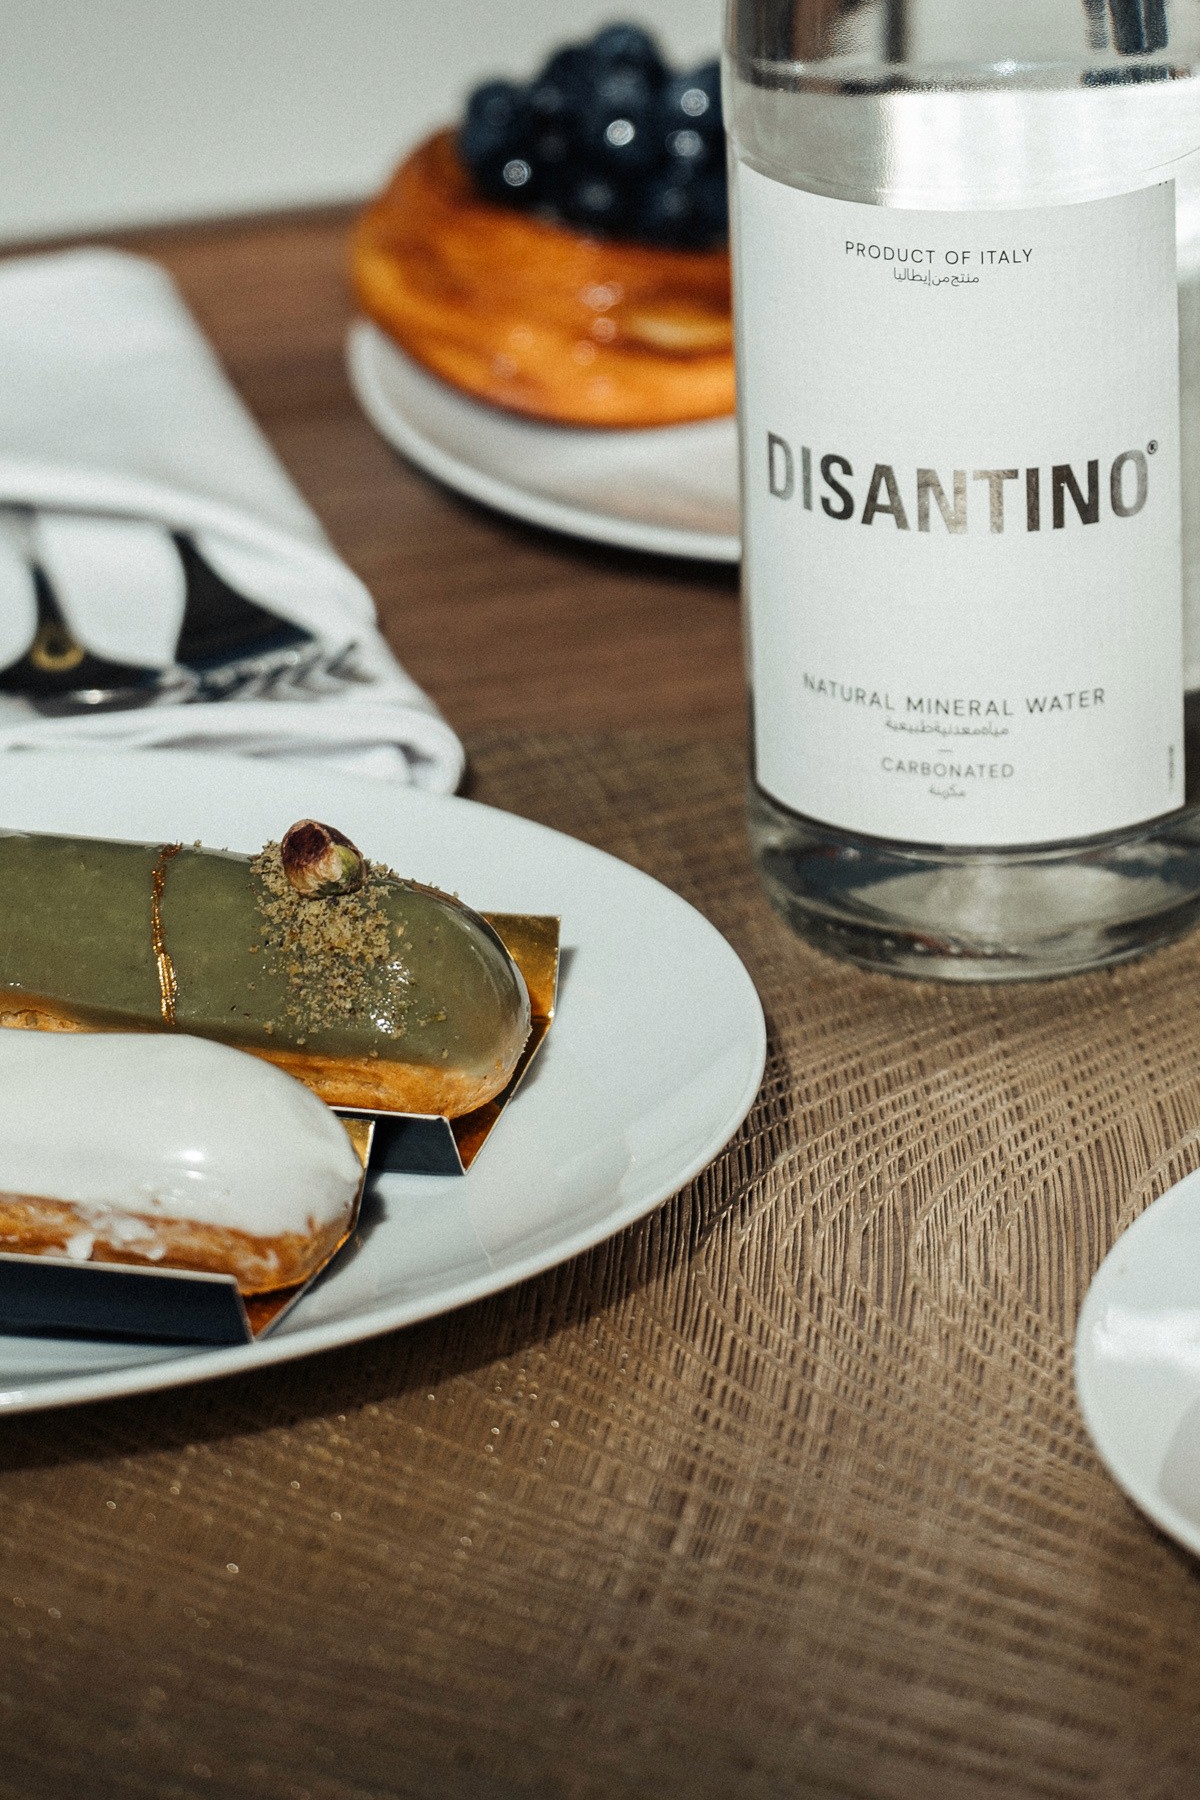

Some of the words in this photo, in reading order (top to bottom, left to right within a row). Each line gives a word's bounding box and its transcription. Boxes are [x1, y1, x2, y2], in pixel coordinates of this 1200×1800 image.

[845, 240, 936, 264] PRODUCT
[944, 249, 972, 265] OF
[980, 248, 1033, 265] ITALY
[803, 672, 895, 711] NATURAL
[906, 696, 1014, 717] MINERAL
[1026, 687, 1105, 715] WATER
[881, 757, 1014, 779] CARBONATED
